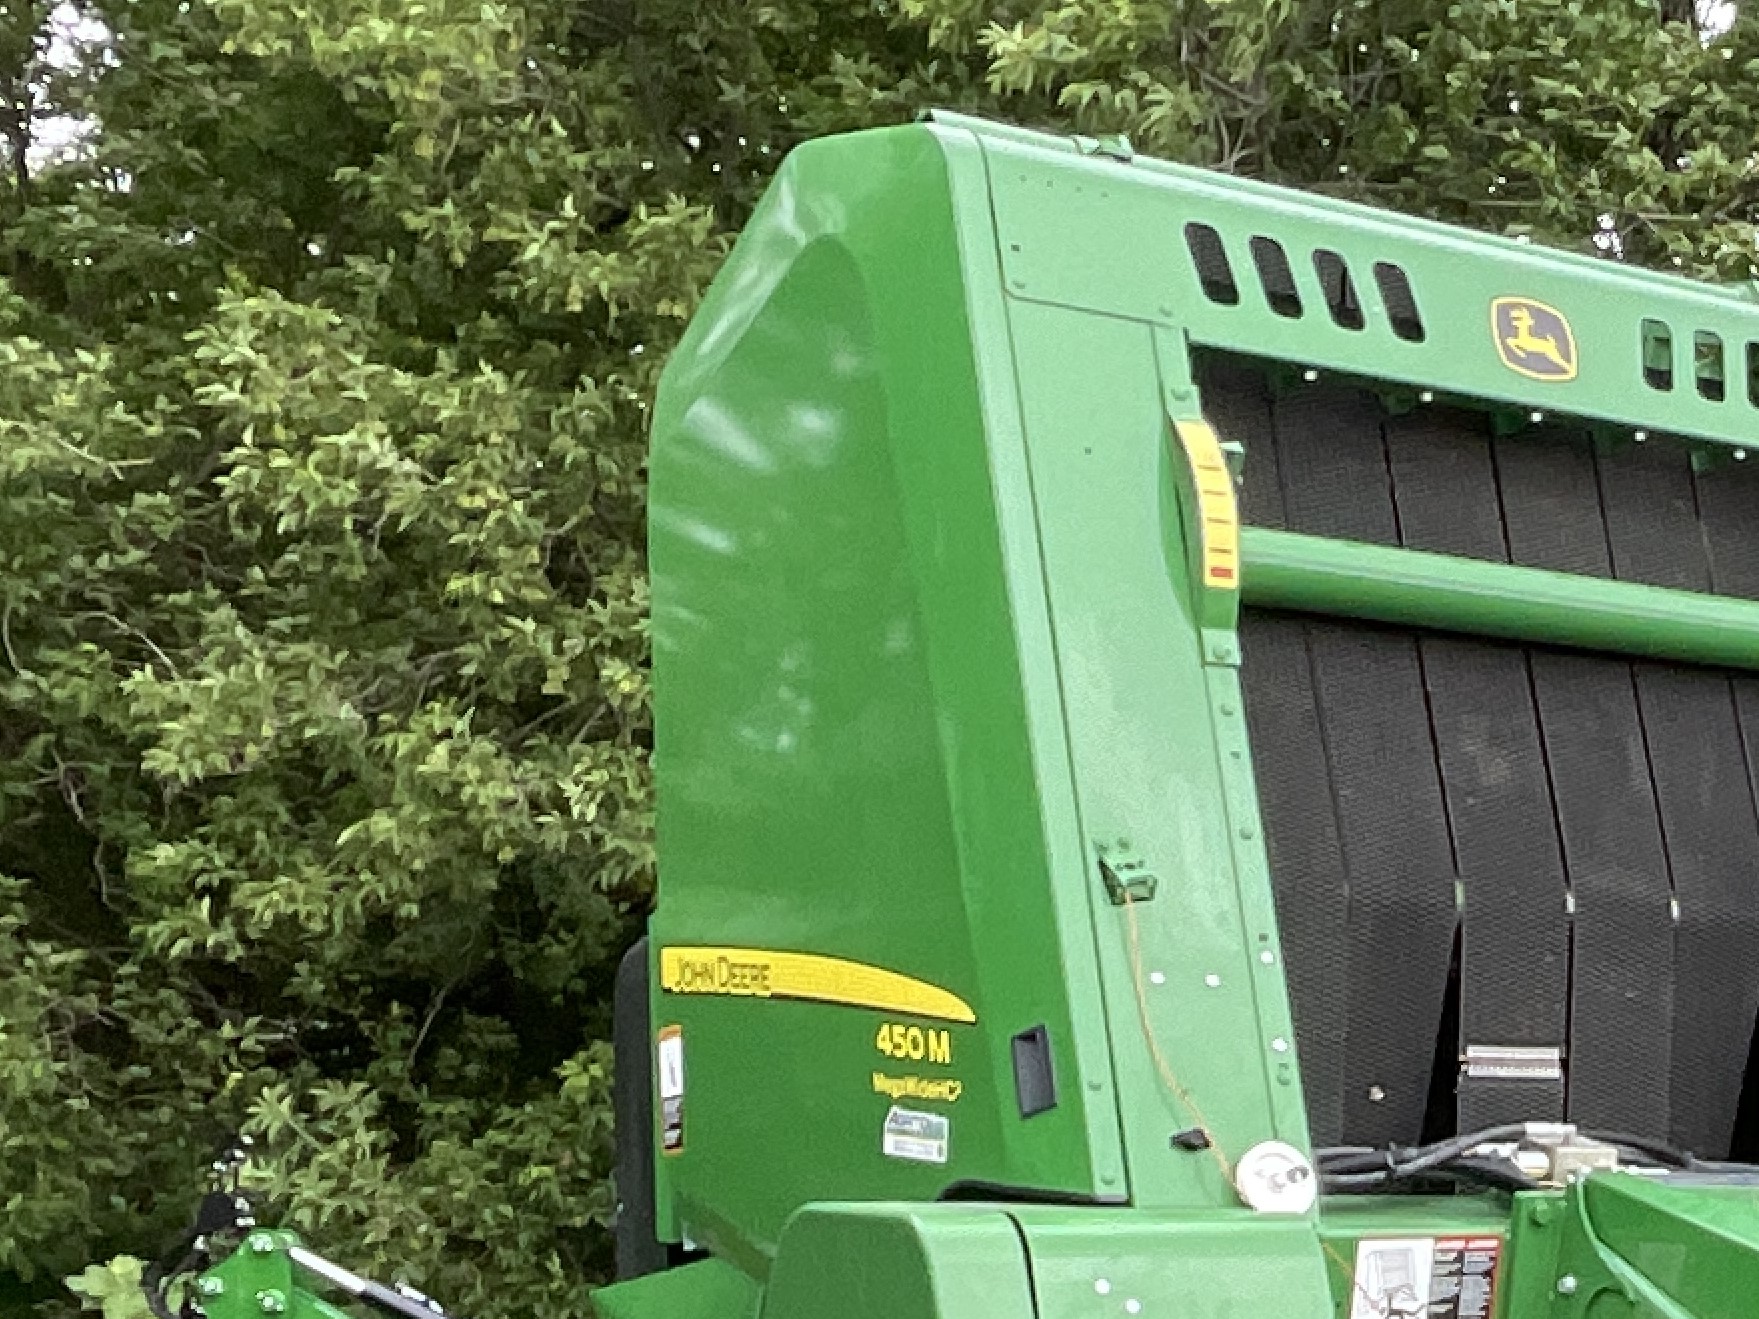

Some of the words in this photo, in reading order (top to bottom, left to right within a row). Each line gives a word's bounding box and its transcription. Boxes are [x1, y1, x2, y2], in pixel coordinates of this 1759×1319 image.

[675, 957, 715, 987] JOHN
[717, 956, 770, 990] DEERE
[876, 1023, 924, 1060] 450
[928, 1028, 950, 1064] M
